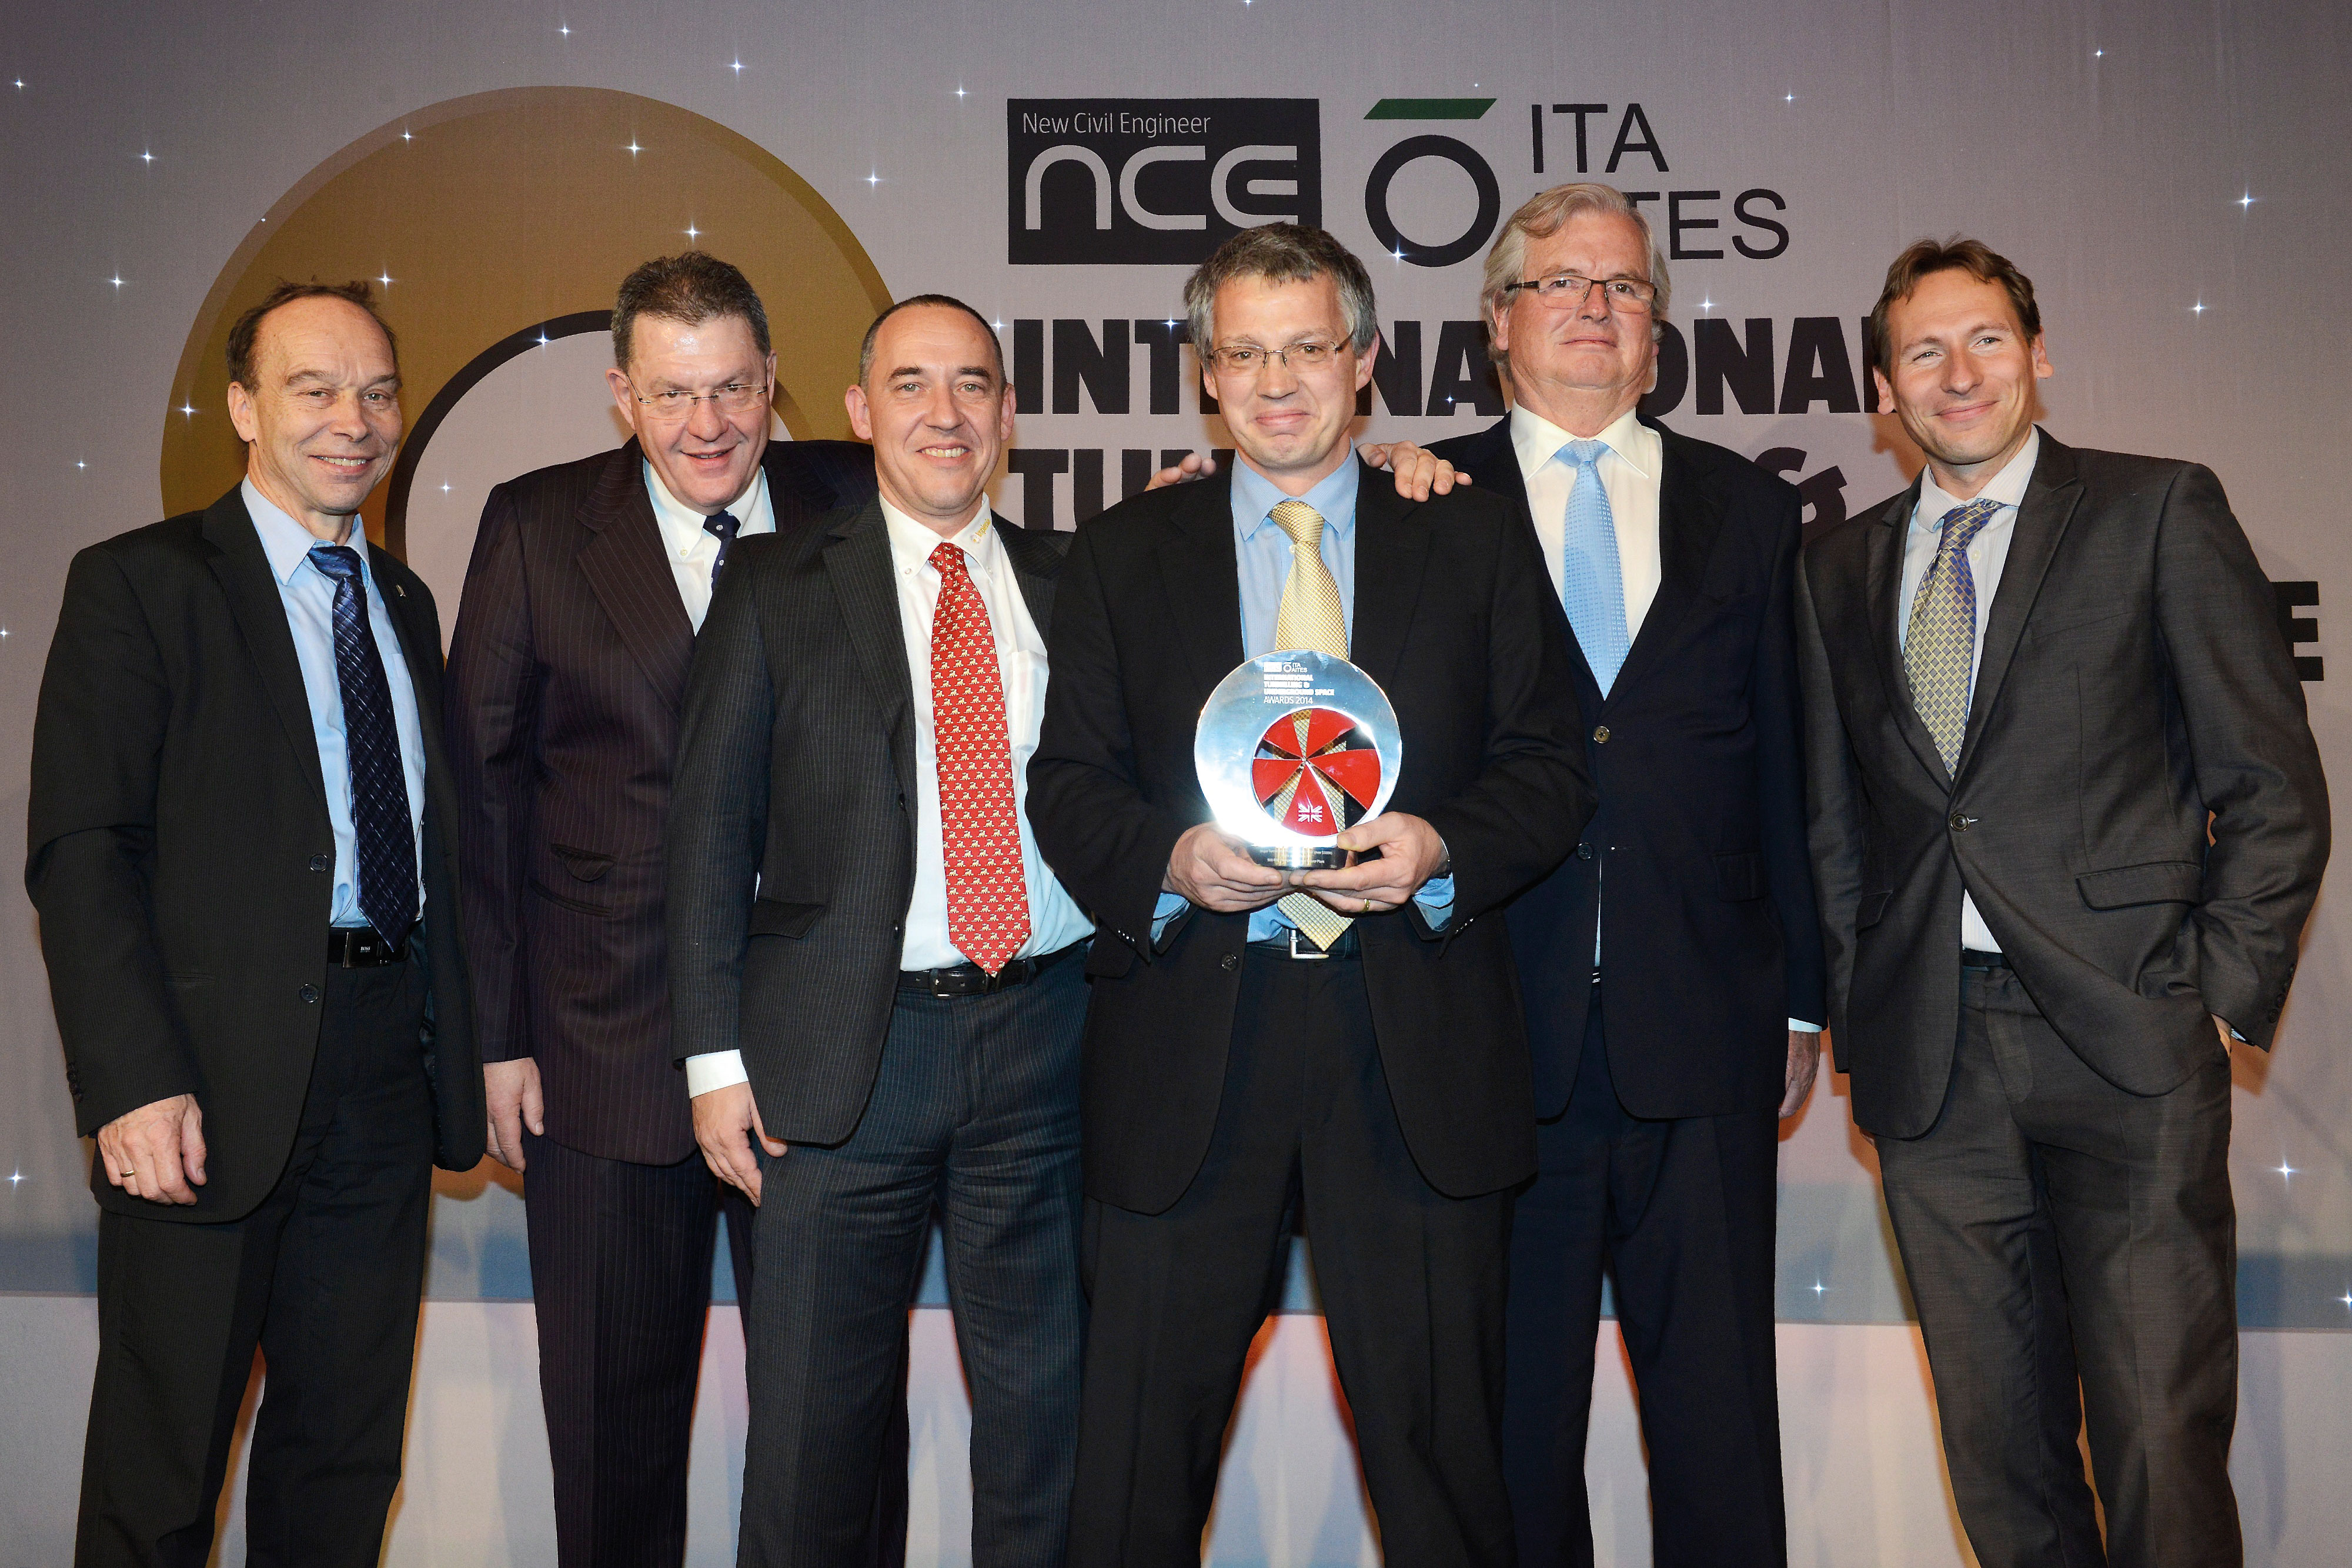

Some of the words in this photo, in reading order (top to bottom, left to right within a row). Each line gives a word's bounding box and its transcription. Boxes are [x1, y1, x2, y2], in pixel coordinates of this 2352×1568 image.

[1023, 112, 1069, 133] New
[1074, 112, 1114, 133] Civil
[1120, 112, 1211, 138] Engineer
[1531, 103, 1670, 173] ITA
[1264, 696, 1294, 704] AWARDS
[1295, 696, 1314, 704] 2014
